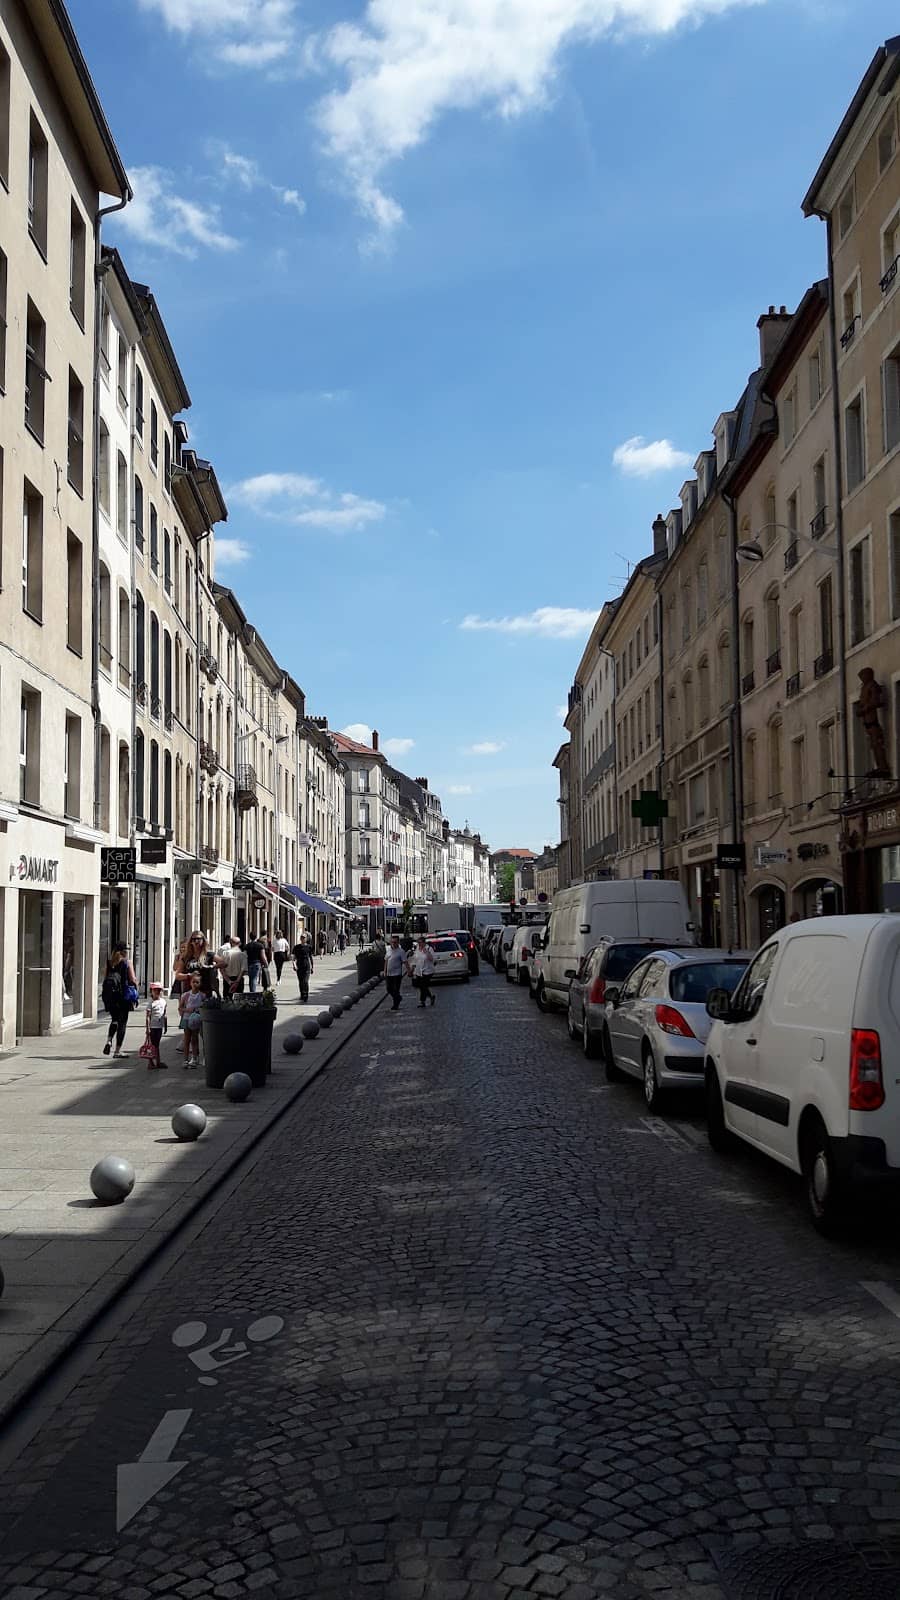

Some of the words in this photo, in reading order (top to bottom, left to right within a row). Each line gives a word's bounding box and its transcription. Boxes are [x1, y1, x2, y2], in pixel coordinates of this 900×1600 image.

[106, 849, 133, 861] Karl
[17, 854, 59, 884] DAMART
[101, 858, 134, 871] Marc
[101, 869, 133, 880] John
